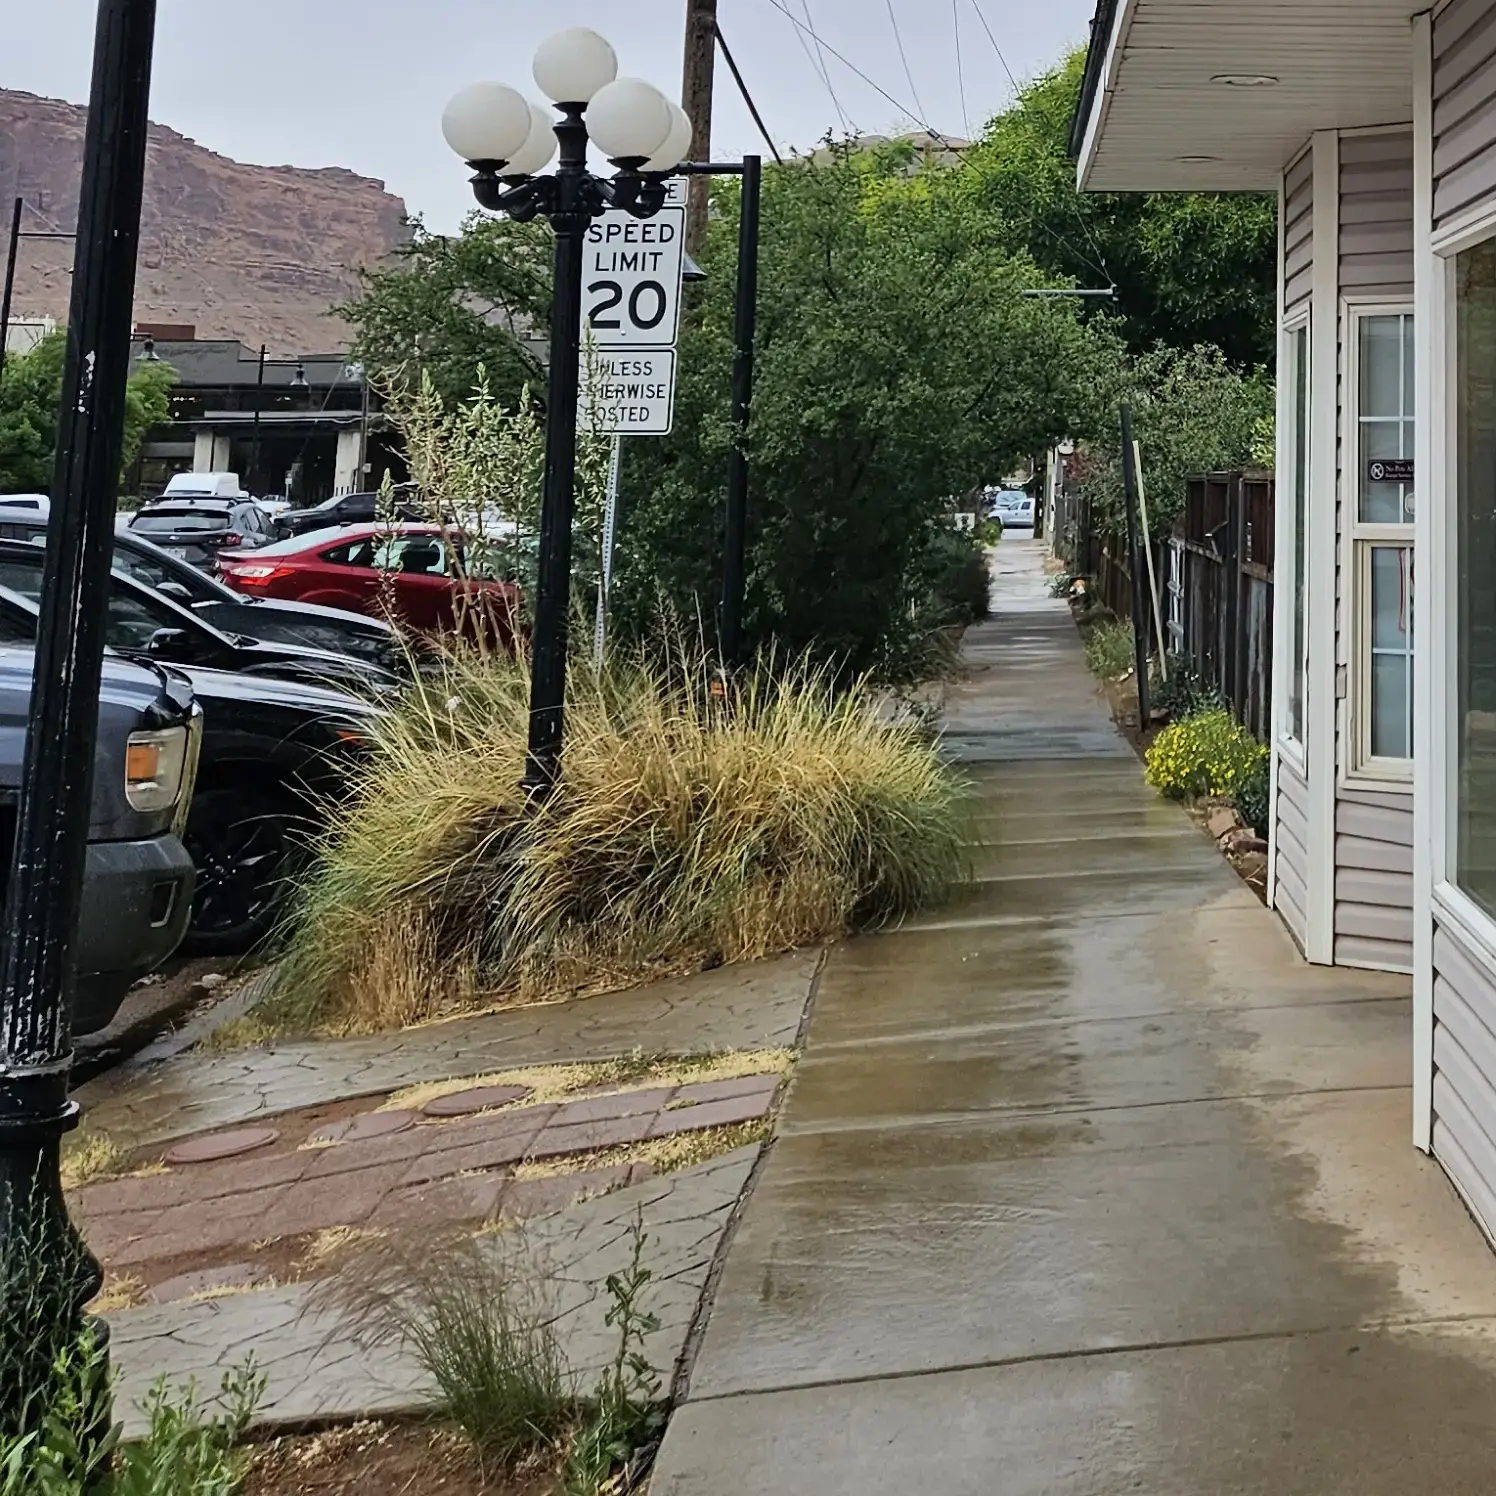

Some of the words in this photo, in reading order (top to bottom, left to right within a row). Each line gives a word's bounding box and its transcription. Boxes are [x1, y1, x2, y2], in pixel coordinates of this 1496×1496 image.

[587, 223, 675, 244] SPEED
[594, 252, 663, 272] LIMIT
[586, 280, 667, 330] 20
